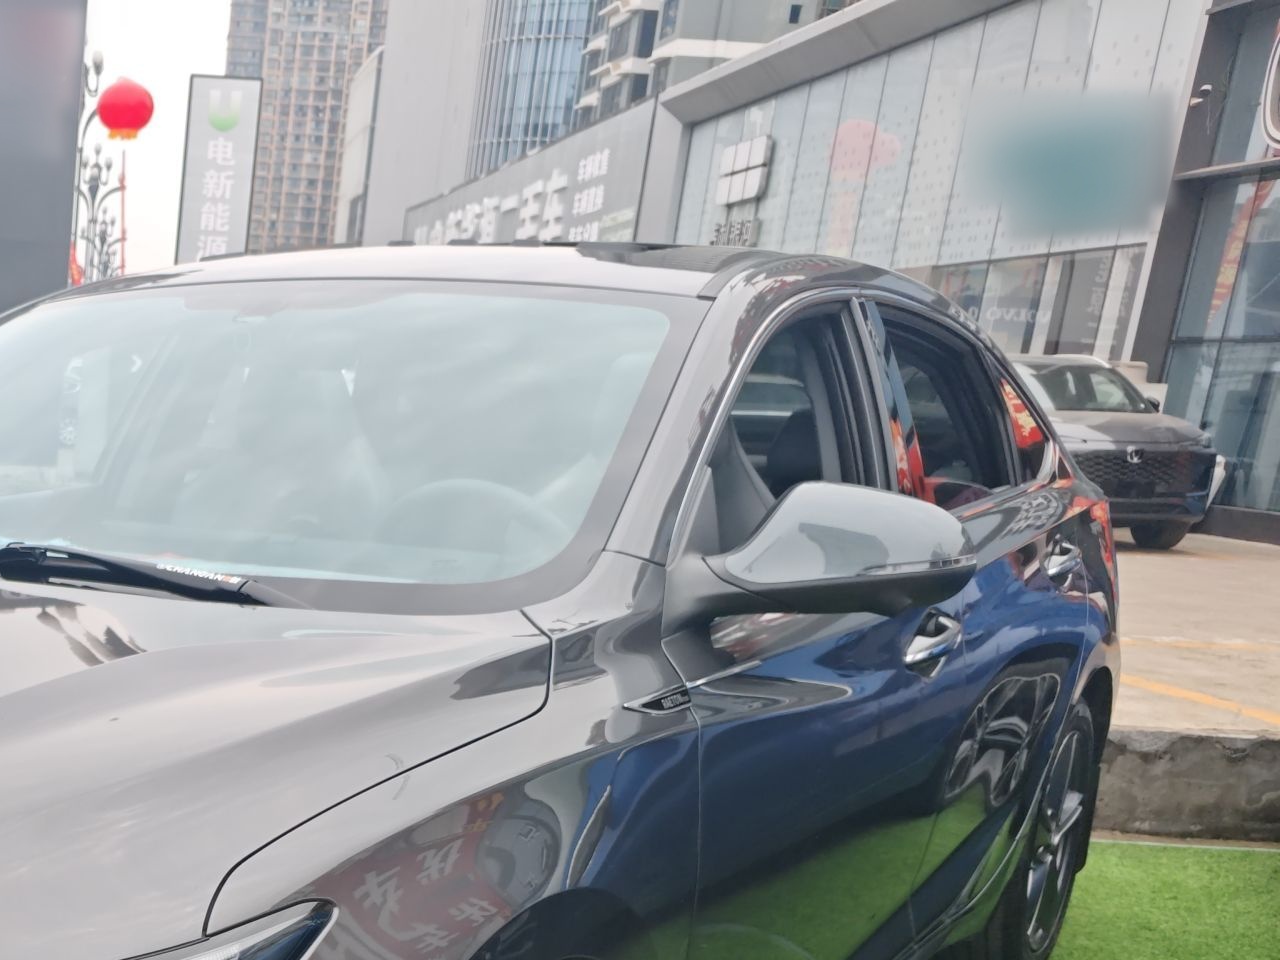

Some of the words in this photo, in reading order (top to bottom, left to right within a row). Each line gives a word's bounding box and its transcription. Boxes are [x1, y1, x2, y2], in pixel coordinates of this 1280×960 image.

[196, 136, 236, 262] 电新能源
[165, 564, 224, 581] CHANGAN
